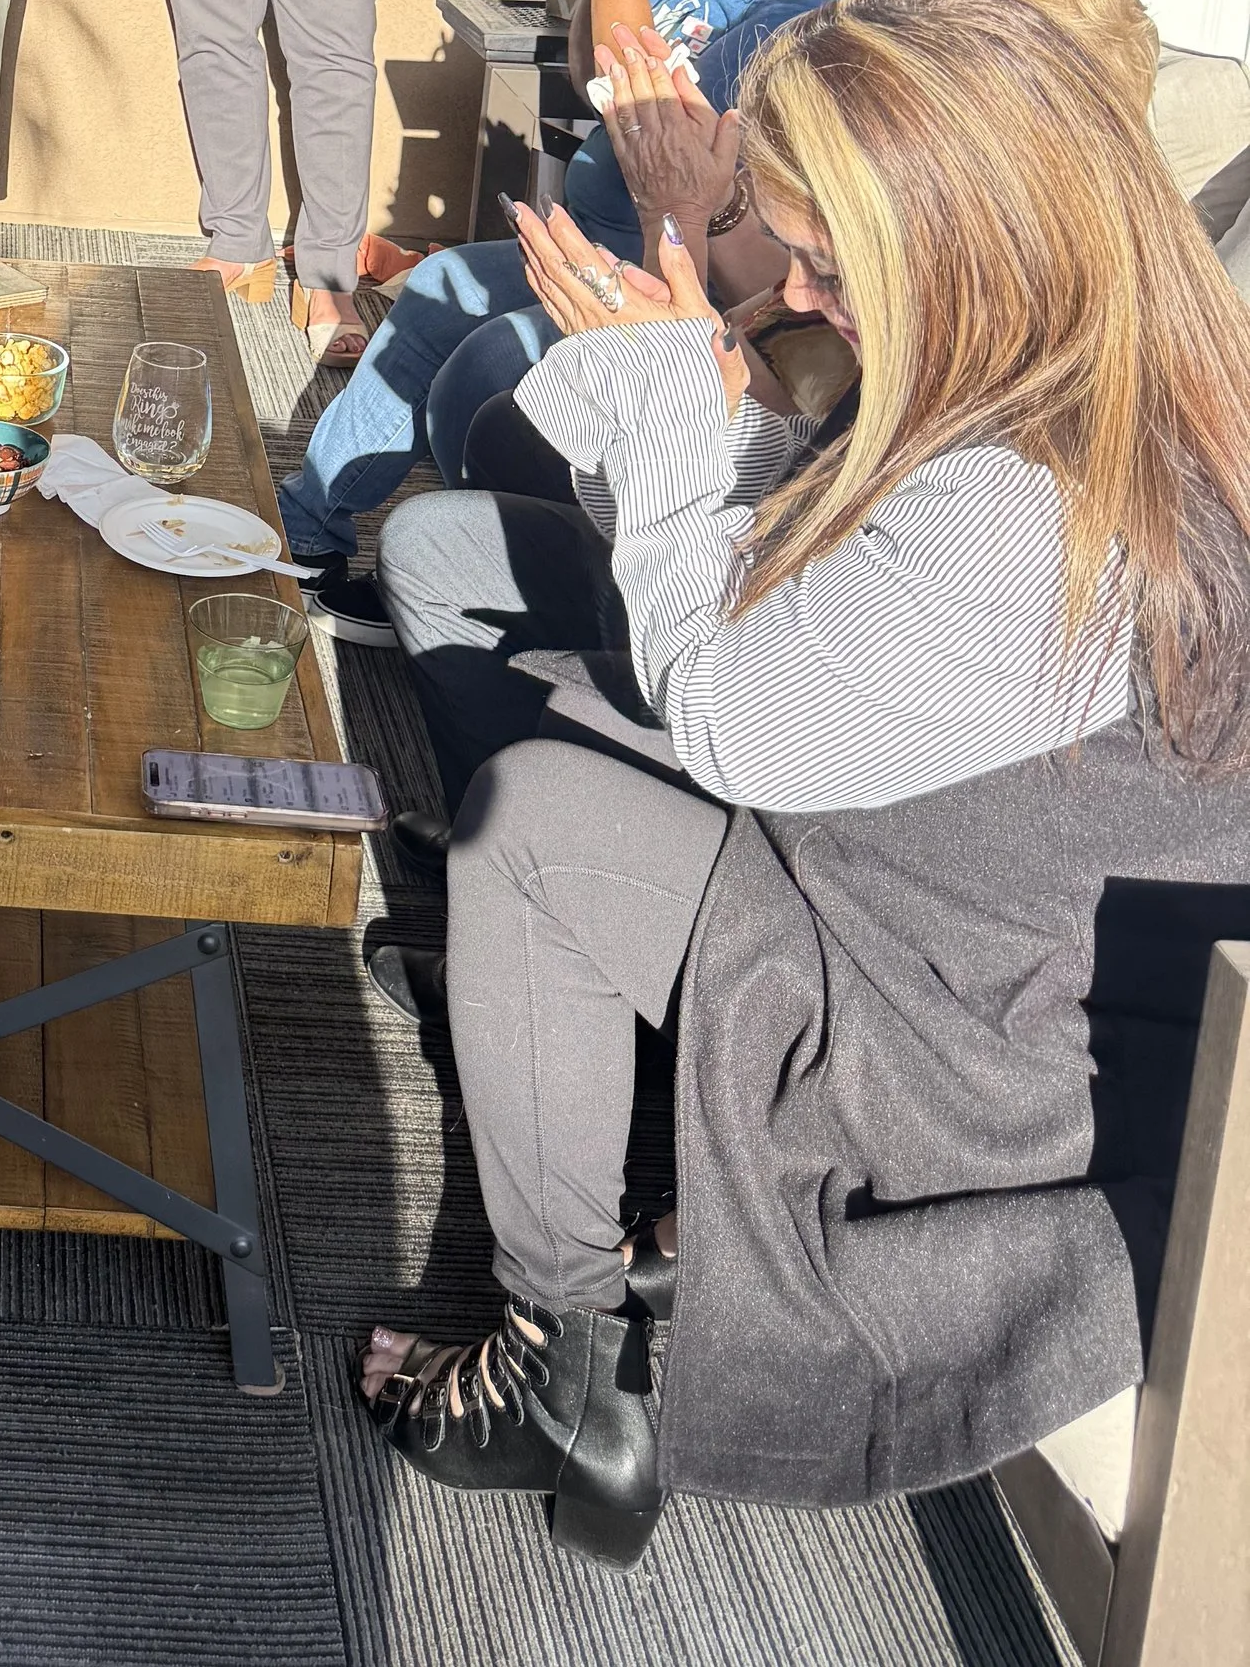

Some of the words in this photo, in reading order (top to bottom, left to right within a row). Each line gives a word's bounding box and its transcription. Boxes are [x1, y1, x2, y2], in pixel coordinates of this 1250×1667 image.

[131, 394, 166, 425] Ring
[143, 423, 161, 438] me
[161, 420, 186, 442] look
